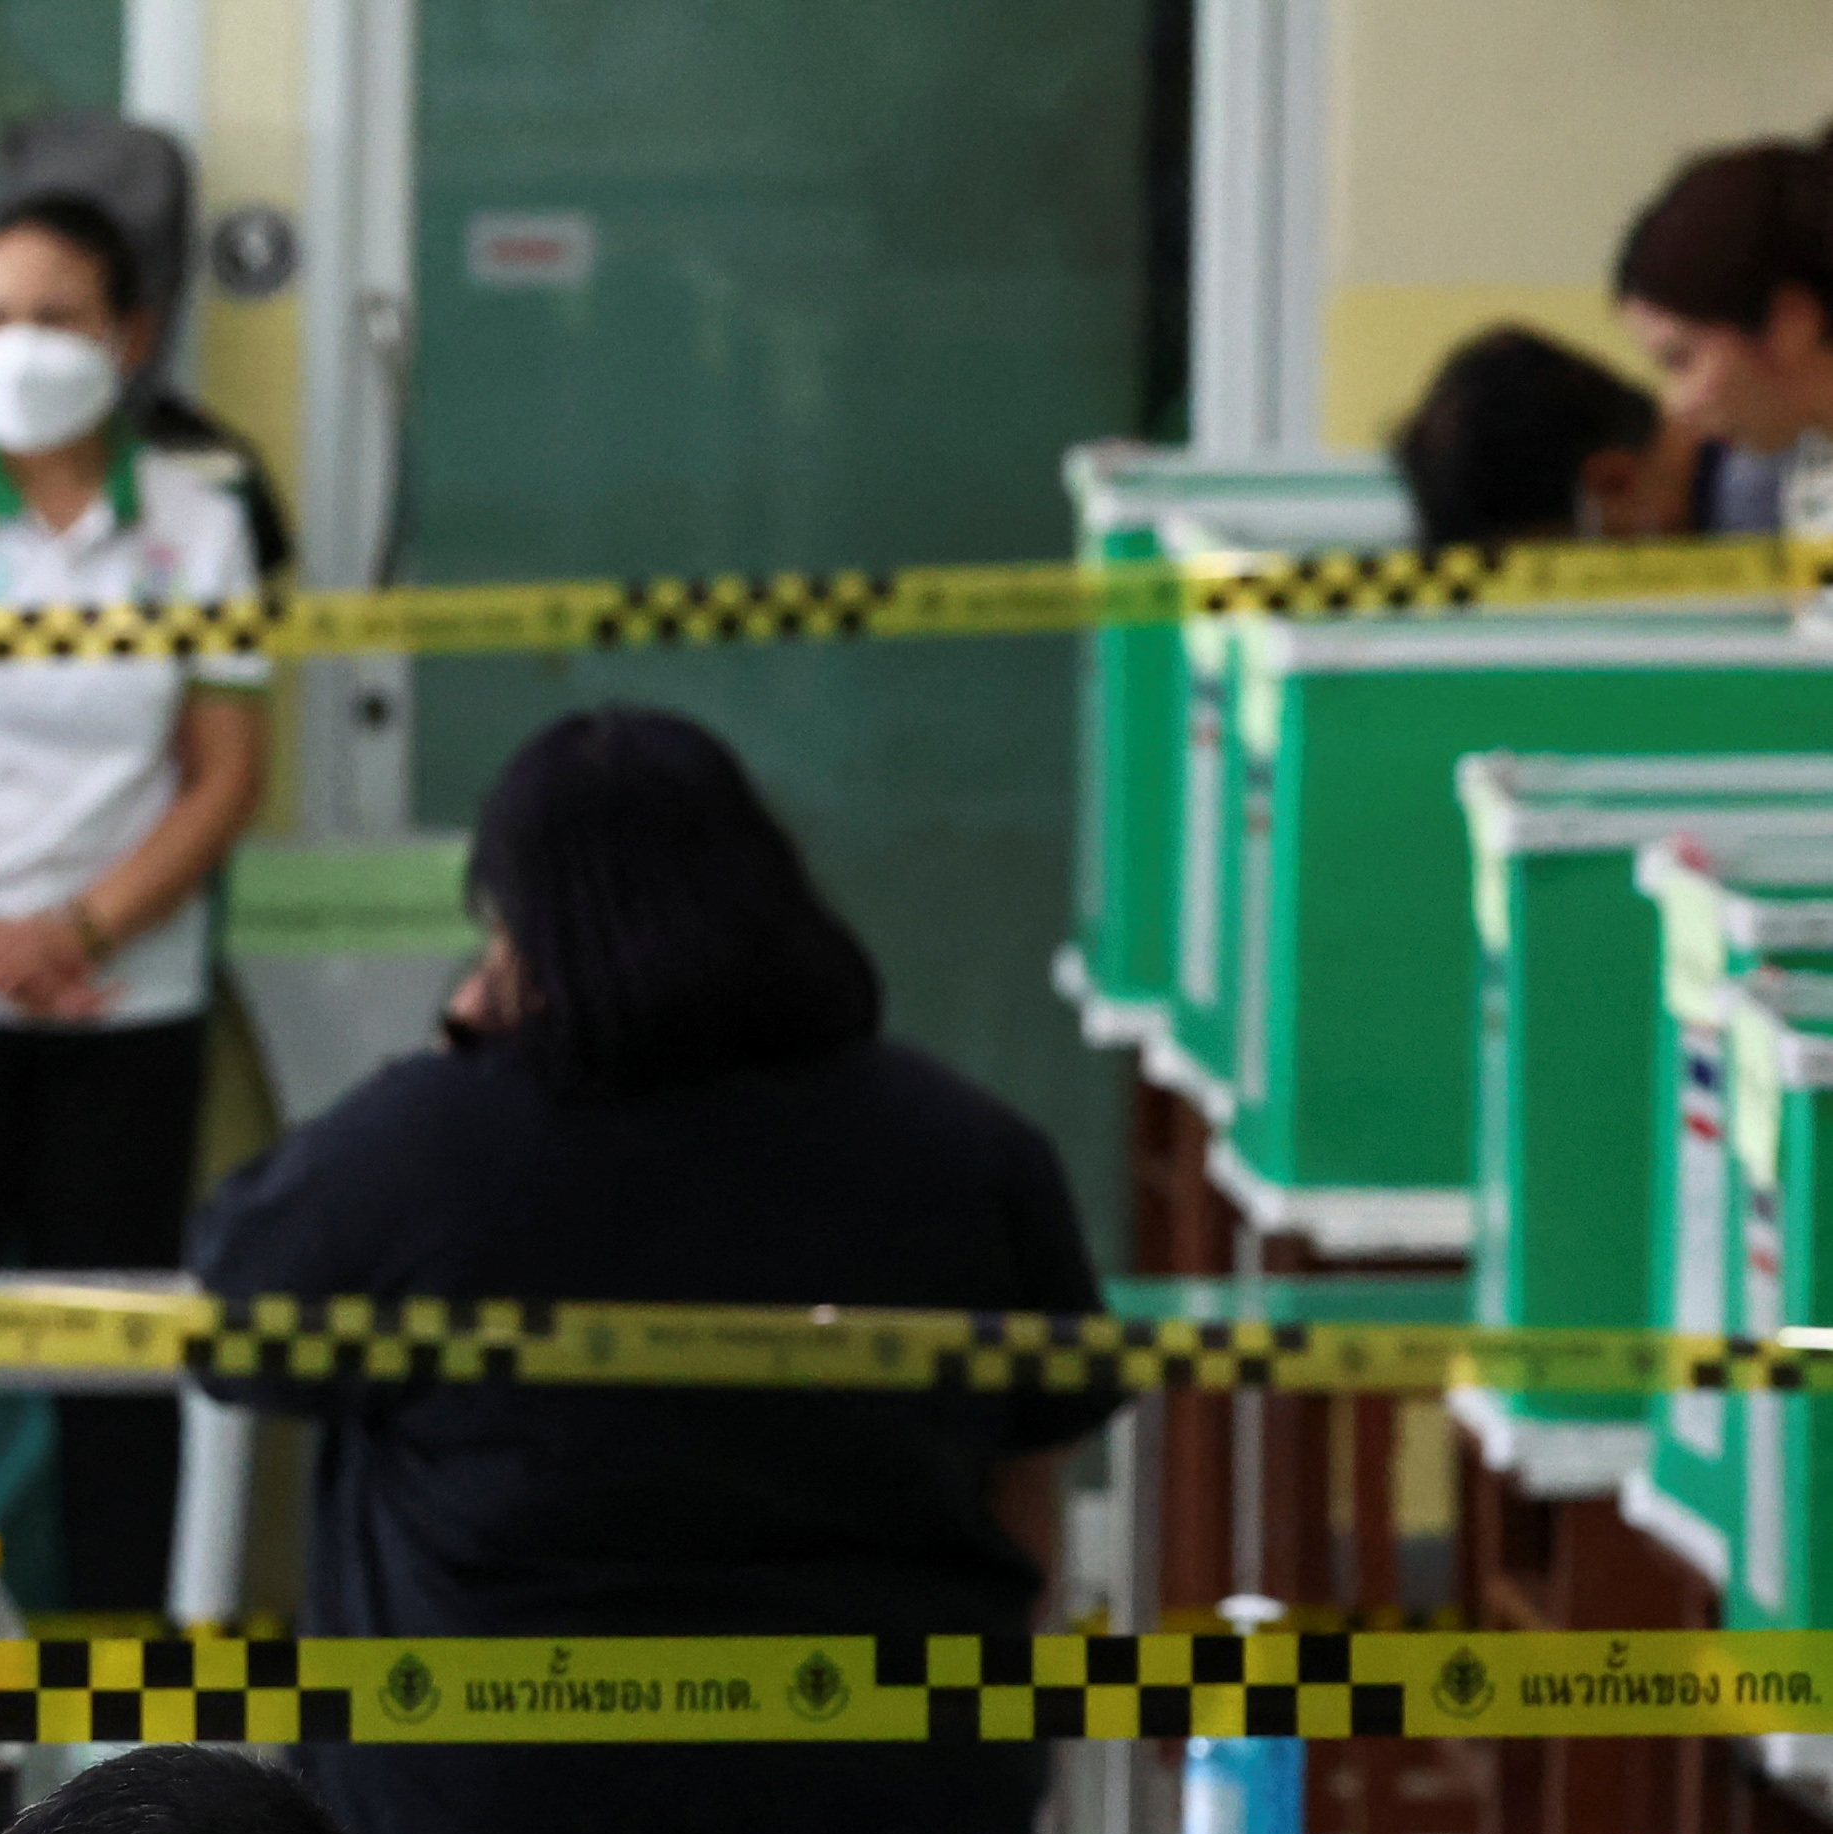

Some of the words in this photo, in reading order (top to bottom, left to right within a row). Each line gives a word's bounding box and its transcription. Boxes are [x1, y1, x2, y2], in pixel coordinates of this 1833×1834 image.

[465, 1646, 662, 1713] แนวกั้นของ
[675, 1677, 761, 1712] กกต.
[1520, 1640, 1720, 1707] แนวกั้นของ
[1736, 1671, 1823, 1705] กกต.
